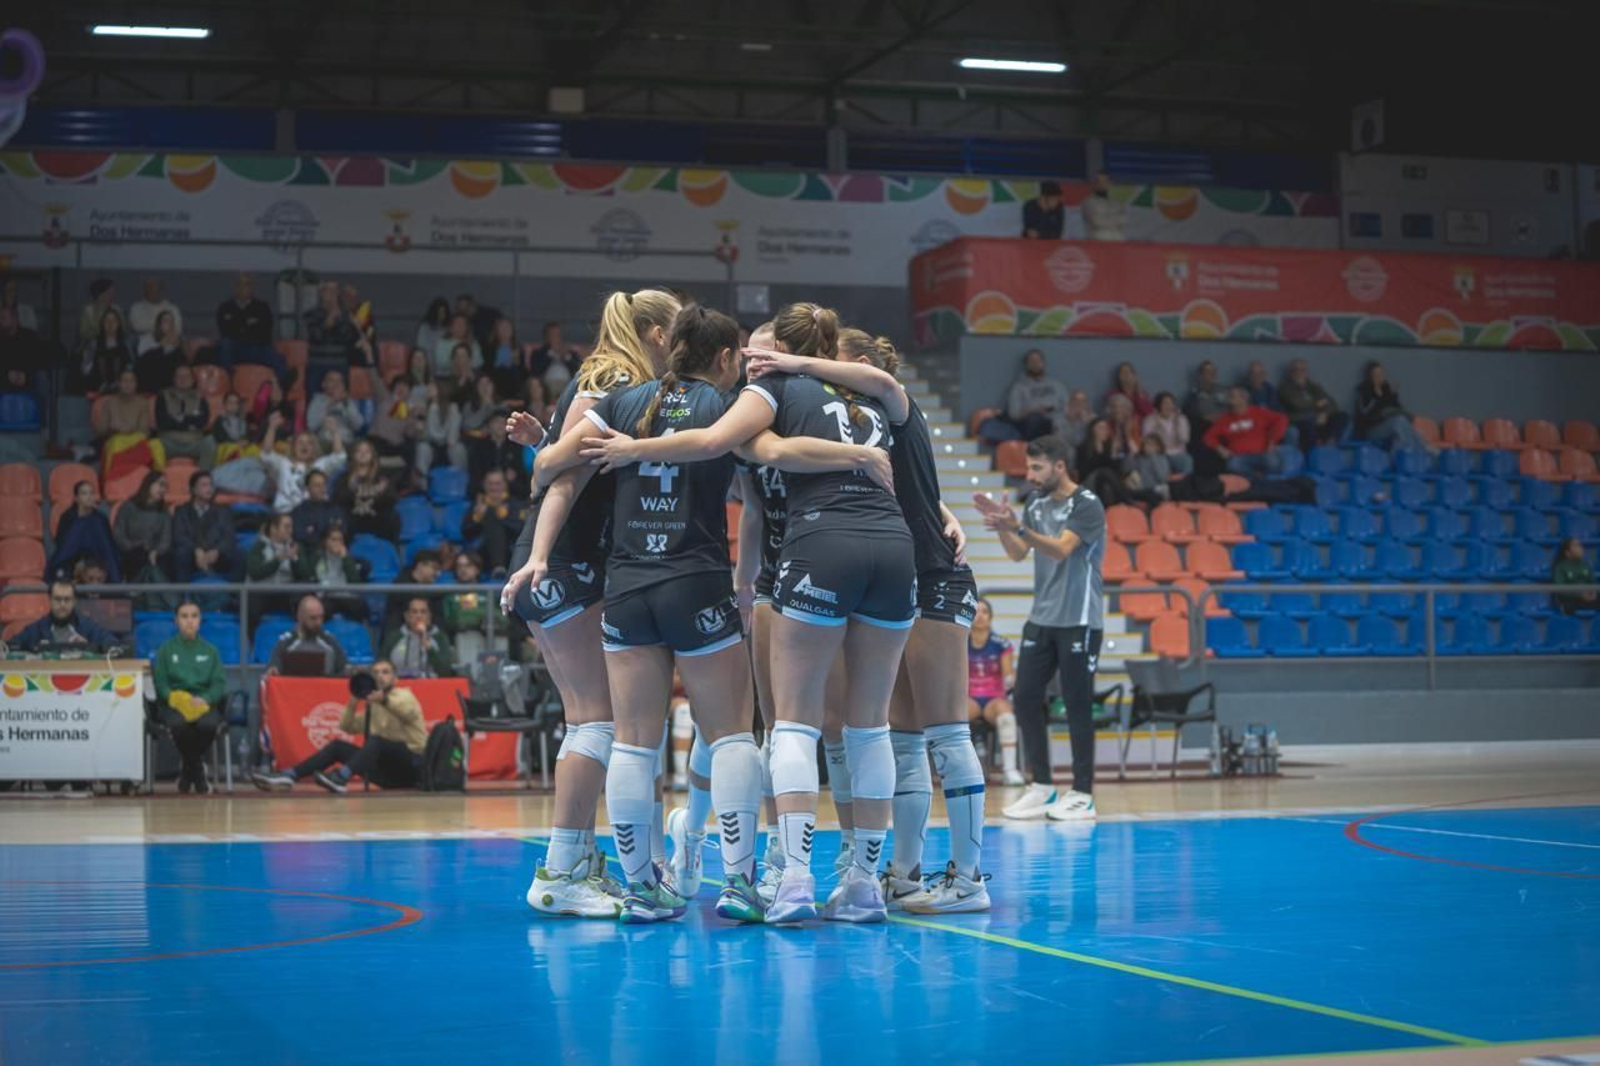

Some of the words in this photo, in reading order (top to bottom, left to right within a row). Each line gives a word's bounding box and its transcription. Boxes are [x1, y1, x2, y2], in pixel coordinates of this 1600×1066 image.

[89, 224, 117, 238] Dos
[120, 226, 190, 240] Hermanas
[430, 230, 457, 244] Dos
[461, 232, 529, 246] Hermanas
[758, 240, 783, 253] Dos
[786, 242, 851, 255] Hermanas
[757, 465, 787, 498] 14
[640, 496, 679, 512] WAY
[71, 707, 90, 721] de
[8, 726, 90, 741] Hermanas
